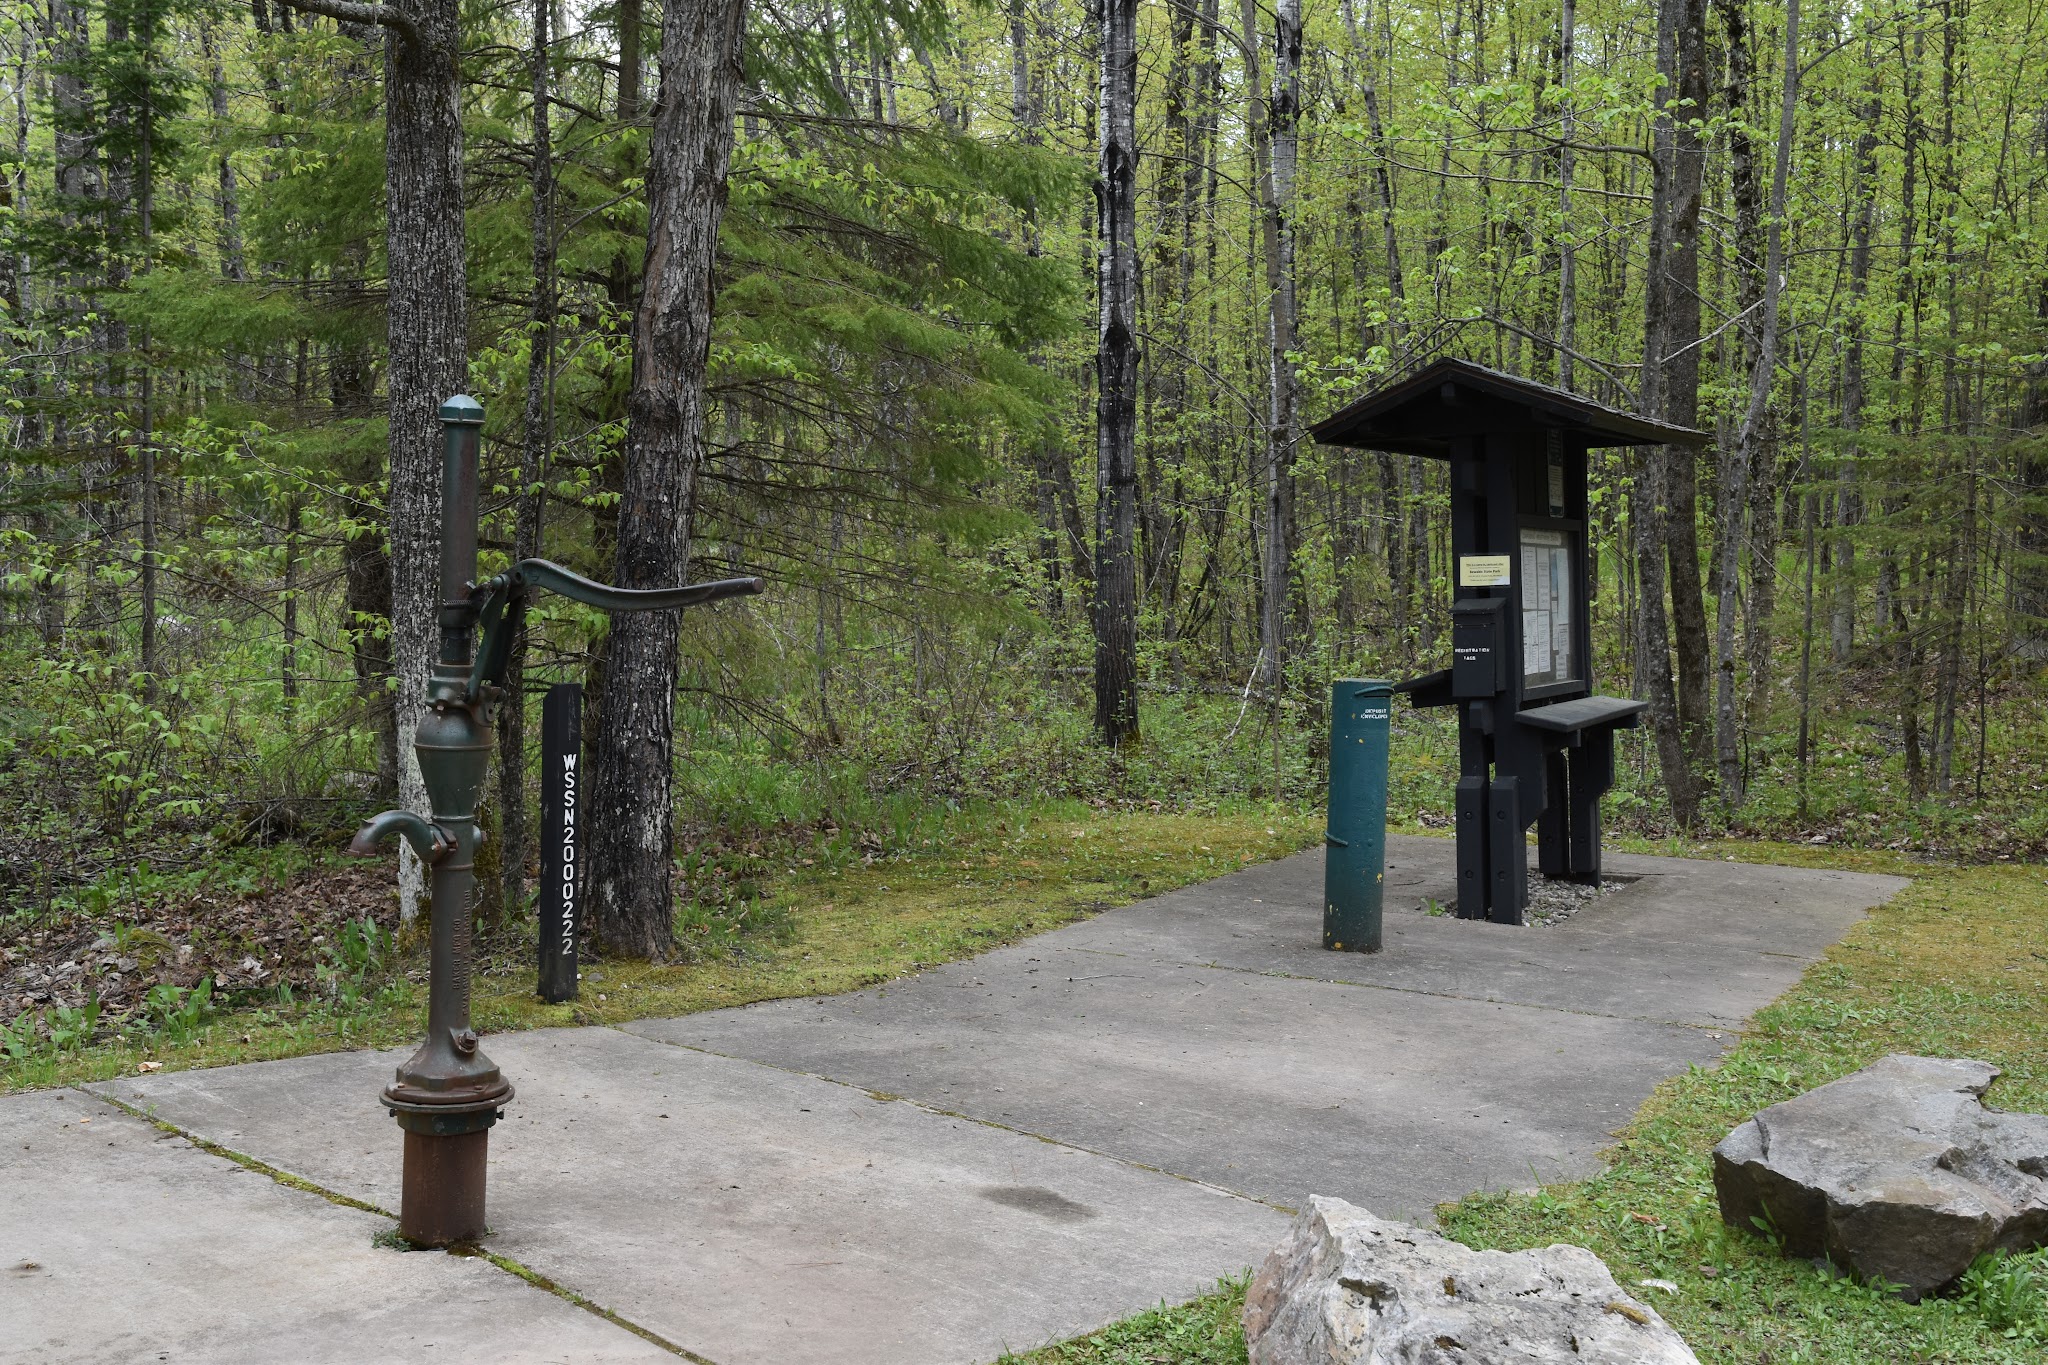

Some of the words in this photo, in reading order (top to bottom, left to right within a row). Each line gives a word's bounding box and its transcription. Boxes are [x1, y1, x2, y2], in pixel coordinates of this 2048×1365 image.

[562, 753, 577, 956] WSSN2000222
[452, 933, 462, 955] MFG
[452, 958, 461, 990] BAKER
[462, 952, 470, 1016] EVANSVILLE
